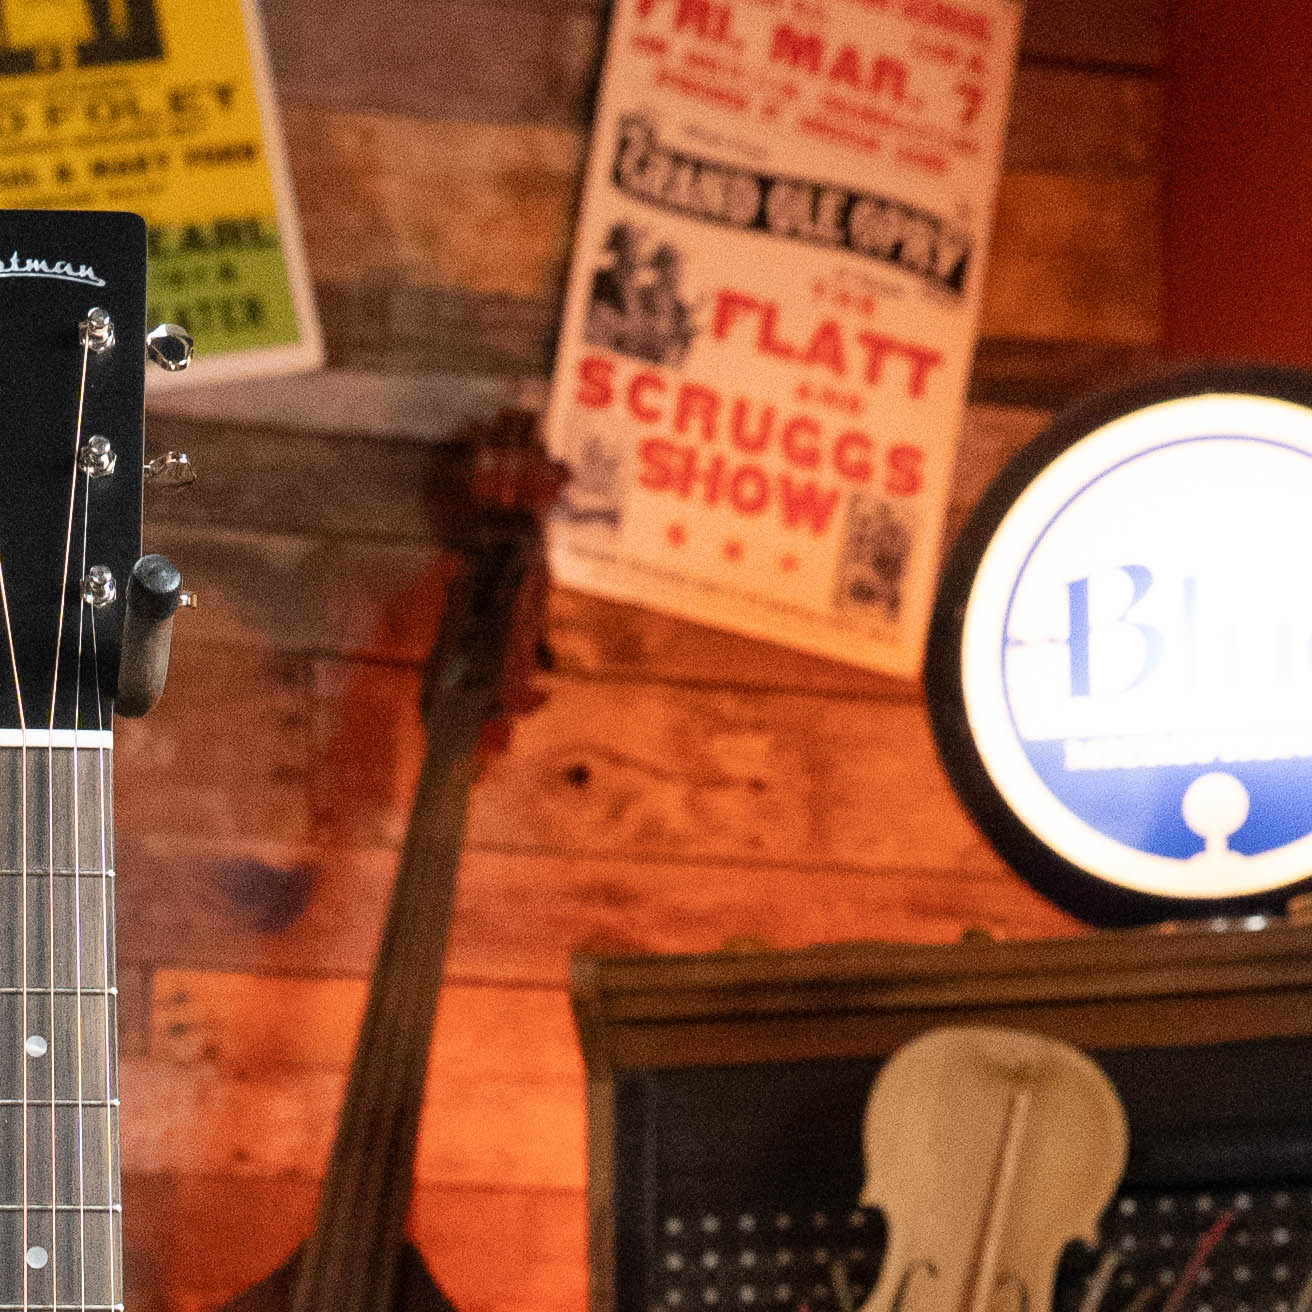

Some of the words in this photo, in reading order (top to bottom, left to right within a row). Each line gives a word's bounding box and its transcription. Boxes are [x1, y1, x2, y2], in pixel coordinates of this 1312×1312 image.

[712, 290, 942, 399] FLATT
[577, 355, 925, 498] SCRUGGS
[637, 437, 840, 535] SHOW
